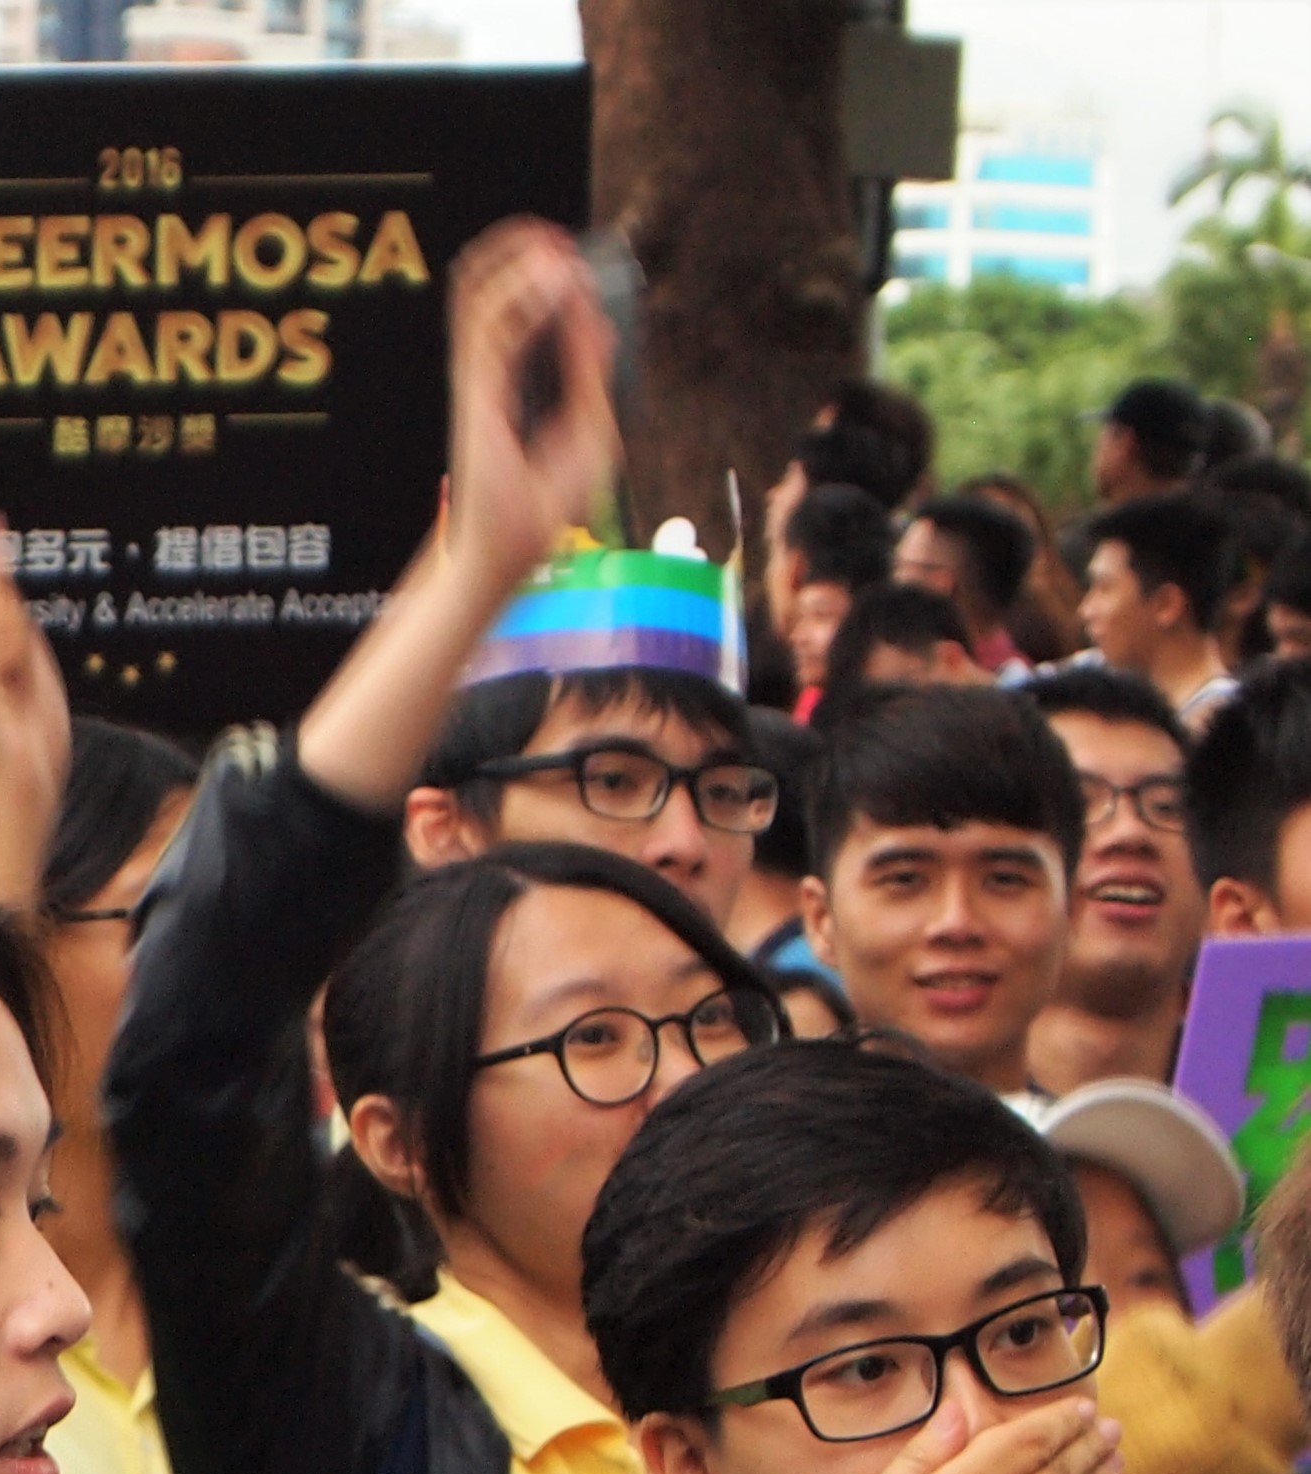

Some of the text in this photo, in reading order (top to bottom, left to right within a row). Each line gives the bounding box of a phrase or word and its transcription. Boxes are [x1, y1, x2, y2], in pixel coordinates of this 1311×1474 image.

[97, 147, 182, 189] 2016
[91, 590, 118, 626] &
[124, 589, 276, 624] Accelerate
